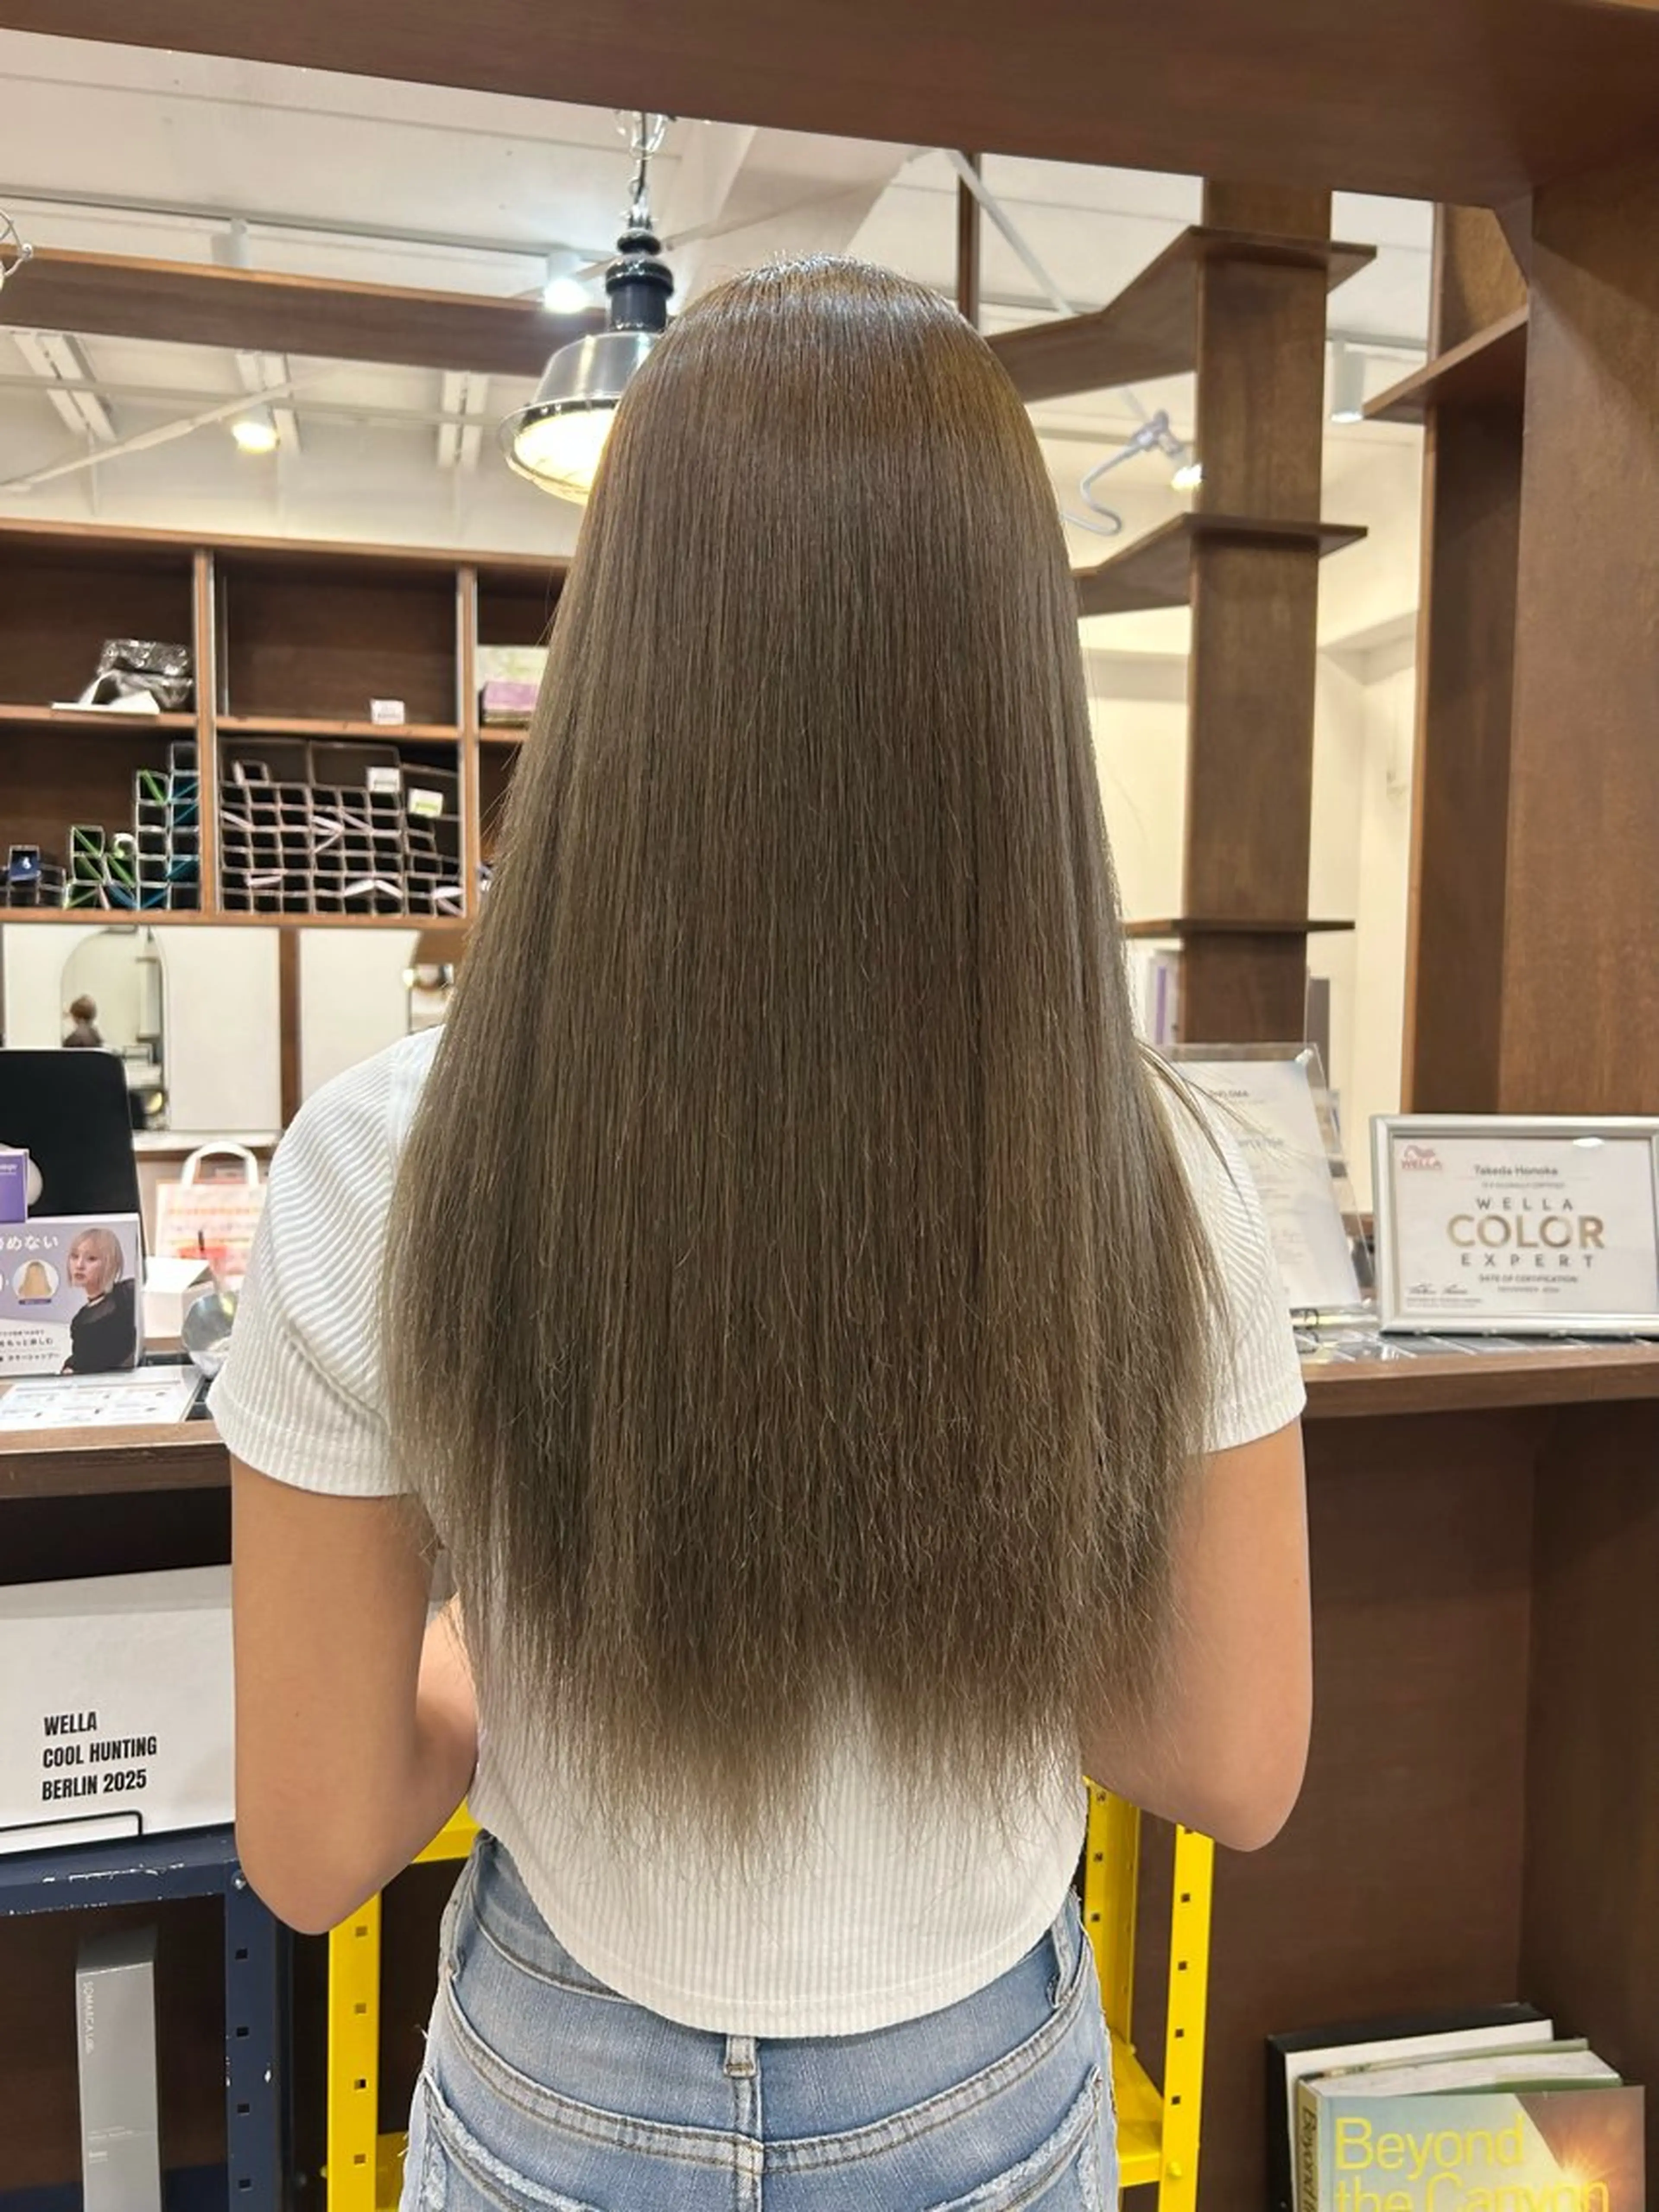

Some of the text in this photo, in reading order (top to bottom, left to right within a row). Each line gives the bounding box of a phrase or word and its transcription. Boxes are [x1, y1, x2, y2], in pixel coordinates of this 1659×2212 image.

[1476, 1197, 1573, 1211] WELLA
[0, 1235, 58, 1250] めない
[1447, 1214, 1605, 1249] COLOR
[1461, 1253, 1593, 1268] EXPERT
[44, 1711, 97, 1736] WELLA
[43, 1736, 156, 1768] COOL HUNTING
[42, 1769, 146, 1801] BERLIN 2025
[1335, 2111, 1525, 2180] Beyond
[1335, 2171, 1610, 2212] the Canyon
